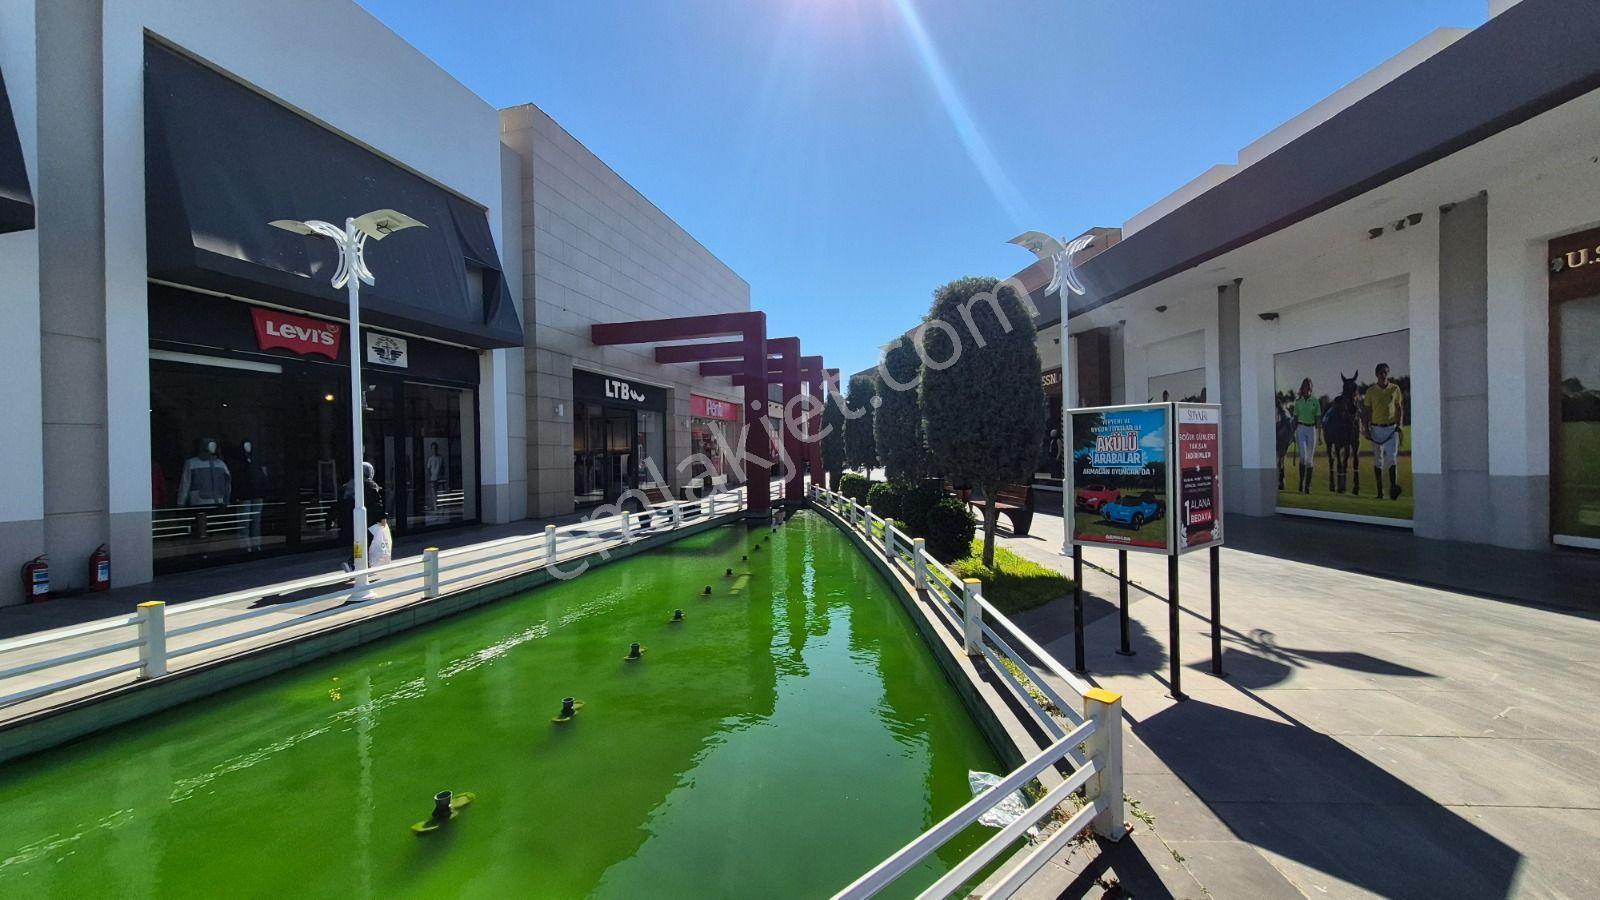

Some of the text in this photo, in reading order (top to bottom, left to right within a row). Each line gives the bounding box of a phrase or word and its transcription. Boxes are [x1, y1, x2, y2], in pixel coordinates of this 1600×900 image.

[605, 379, 630, 400] LTB
[1097, 431, 1138, 452] AKÜLÜ
[1094, 452, 1141, 464] ARABALAR
[1190, 498, 1211, 509] ALANA
[1190, 511, 1212, 523] BEDAVA
